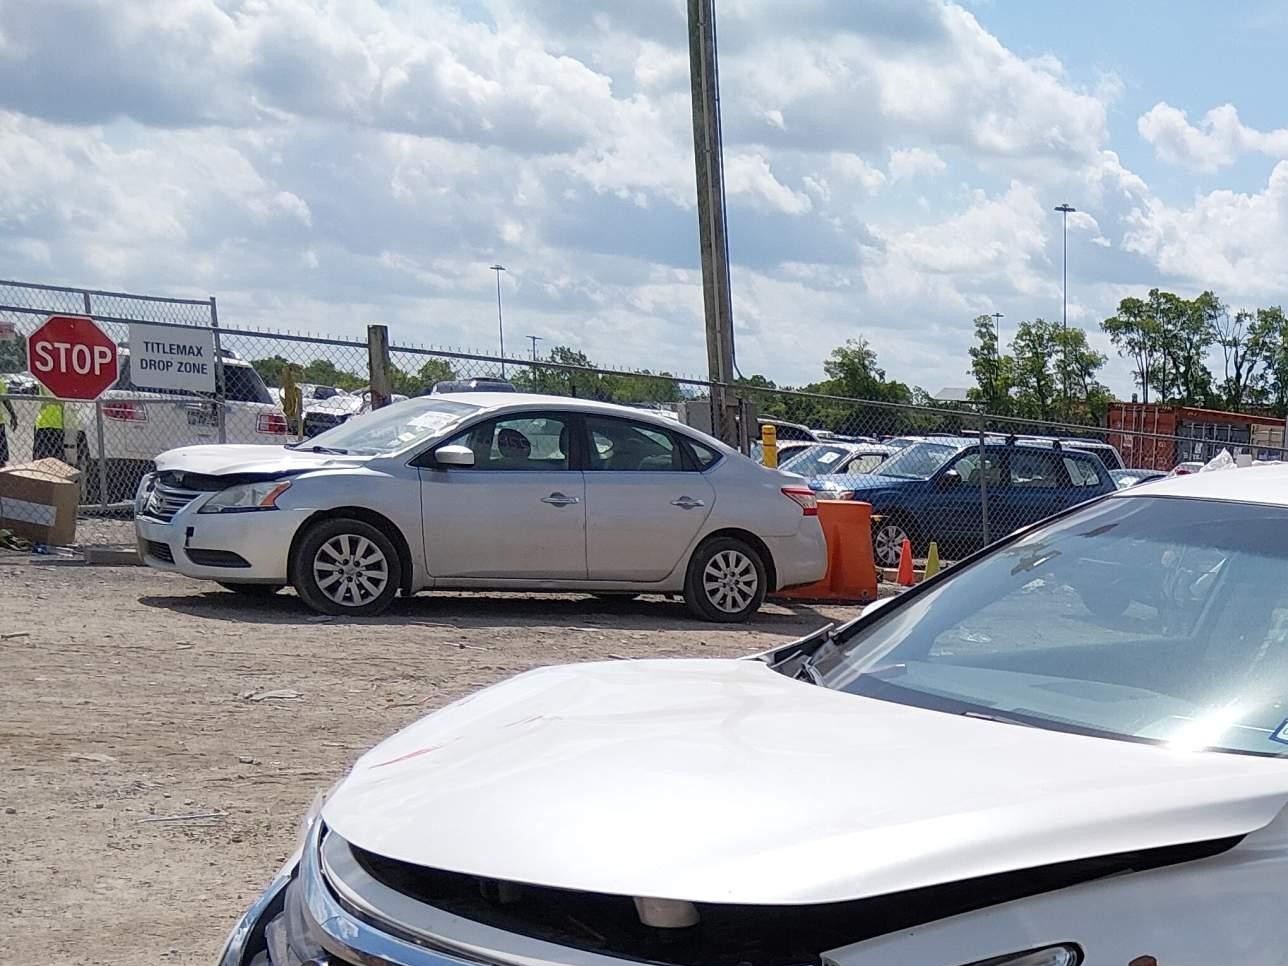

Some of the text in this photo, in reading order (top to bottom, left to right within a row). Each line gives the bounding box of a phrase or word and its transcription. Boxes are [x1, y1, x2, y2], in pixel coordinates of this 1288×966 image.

[143, 341, 204, 358] TITLEMAX
[34, 341, 112, 376] STOP
[140, 358, 208, 375] DROP ZONE
